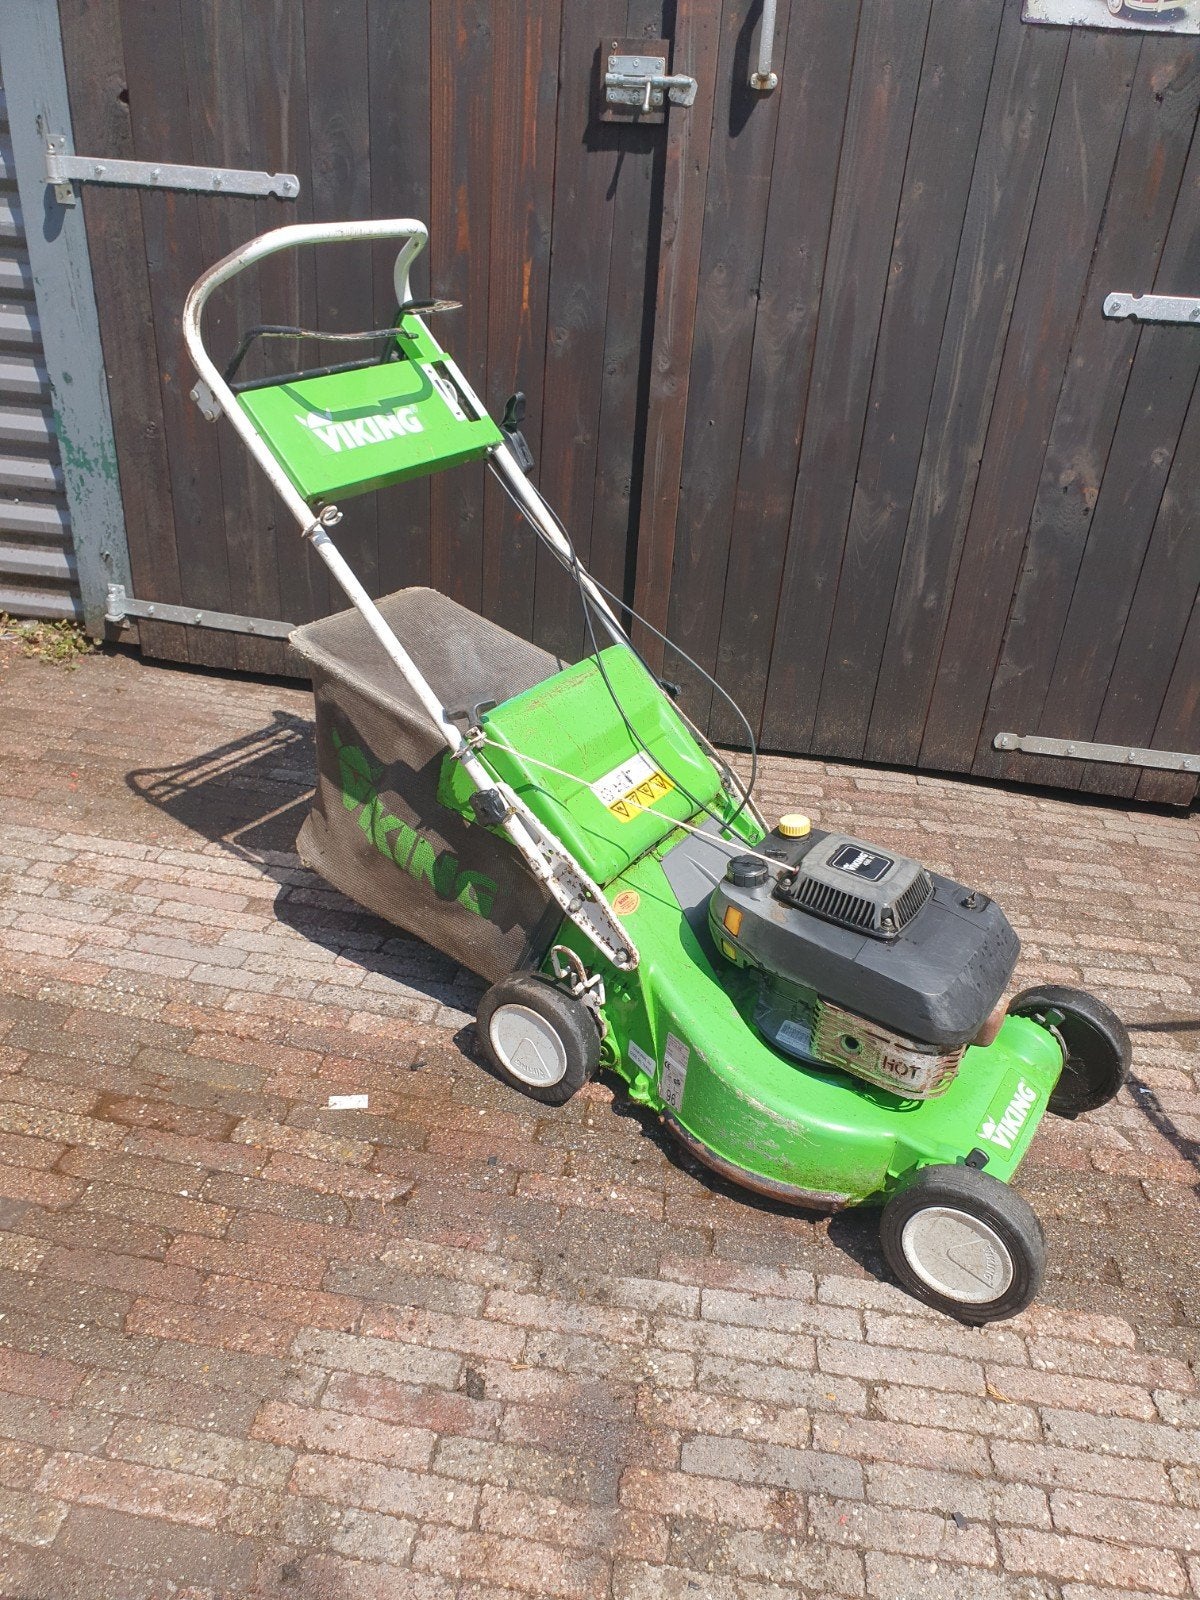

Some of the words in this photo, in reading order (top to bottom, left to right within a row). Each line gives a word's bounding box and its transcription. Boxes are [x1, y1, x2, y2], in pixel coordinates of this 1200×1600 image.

[312, 407, 424, 452] VIKING
[882, 1055, 921, 1079] HOT
[666, 1089, 676, 1106] 96
[990, 1081, 1037, 1149] VIKING
